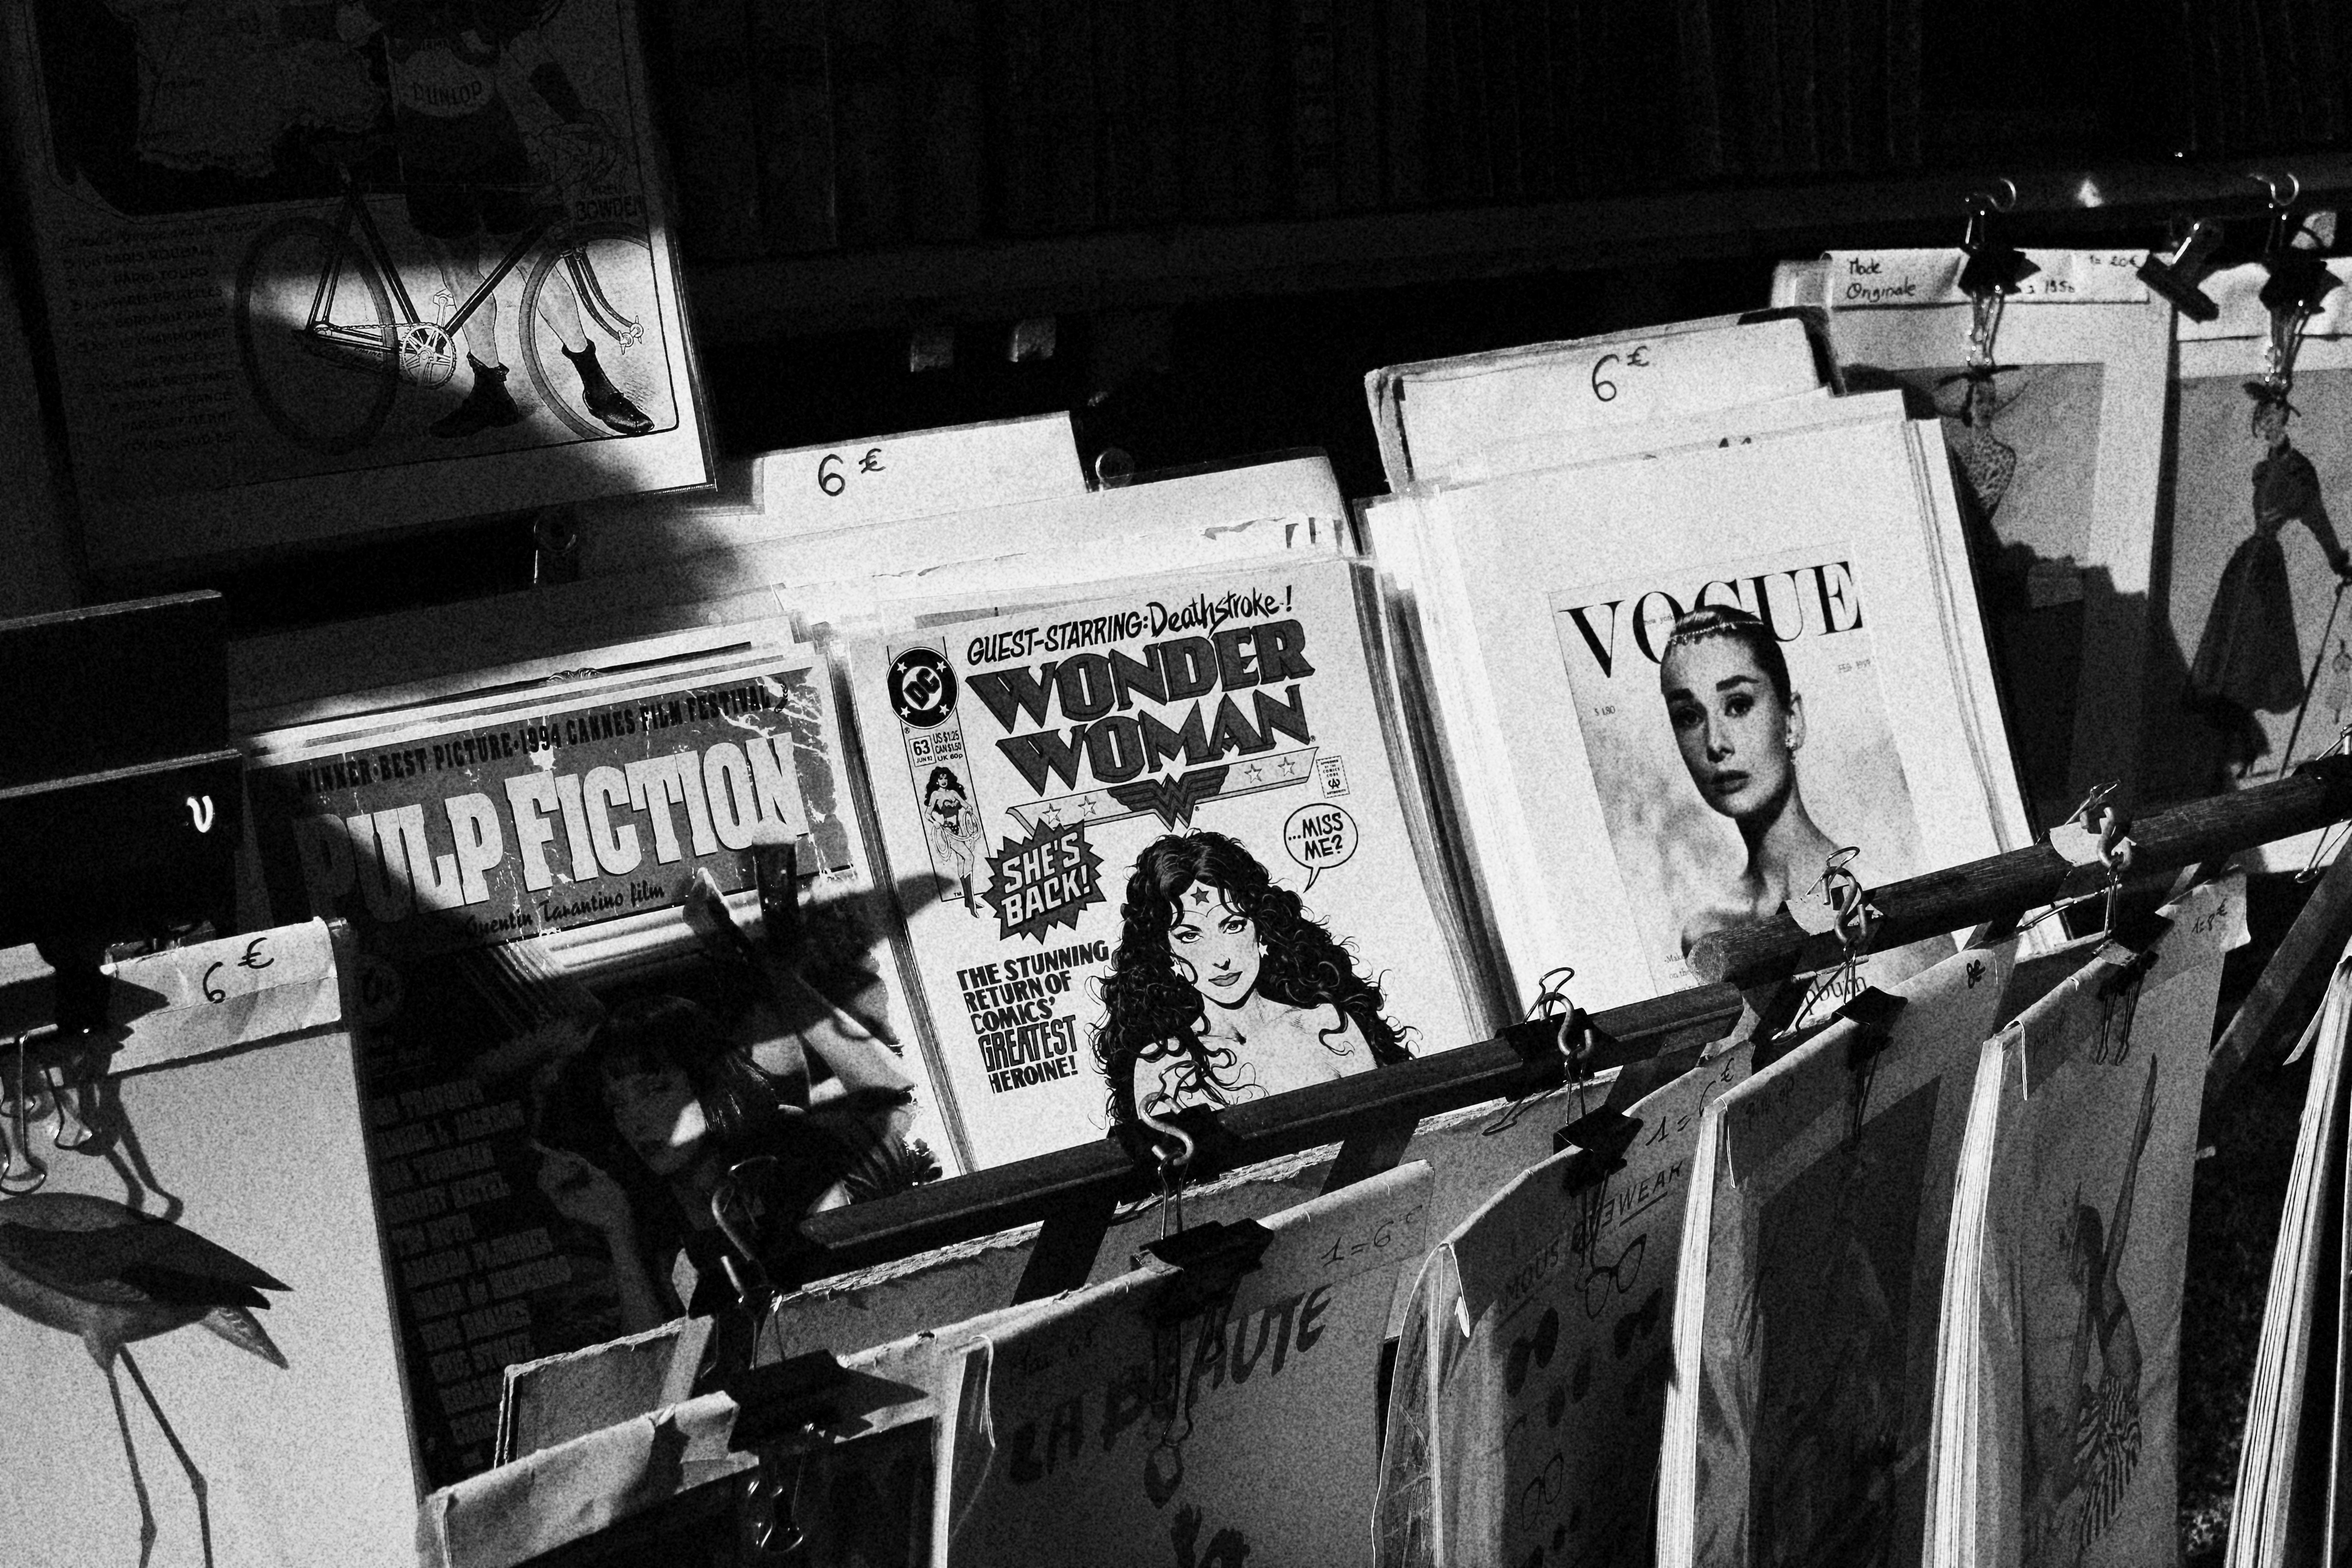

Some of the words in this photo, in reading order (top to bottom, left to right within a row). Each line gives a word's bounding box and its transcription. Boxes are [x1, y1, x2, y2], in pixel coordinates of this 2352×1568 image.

[966, 619, 1315, 734] WONDER
[565, 709, 636, 745] CANNES
[640, 701, 682, 731] FILM
[688, 686, 770, 723] FESTIVAL
[933, 732, 943, 744] US
[996, 684, 1310, 797] WOMAN
[913, 739, 931, 756] 63
[292, 792, 504, 923] PULP
[505, 732, 810, 893] FICTION
[1304, 835, 1344, 861] ME?
[1001, 831, 1082, 894] SHE'S
[539, 894, 624, 923] Tarantino
[630, 882, 665, 908] film
[1001, 864, 1093, 928] BACK!
[956, 963, 1000, 992] THE
[1004, 940, 1110, 981] STUNNING
[963, 976, 1044, 1013] RETURN
[1046, 969, 1073, 994] OF
[978, 1014, 1079, 1073] GREATEST
[988, 1055, 1079, 1095] HEROINE!
